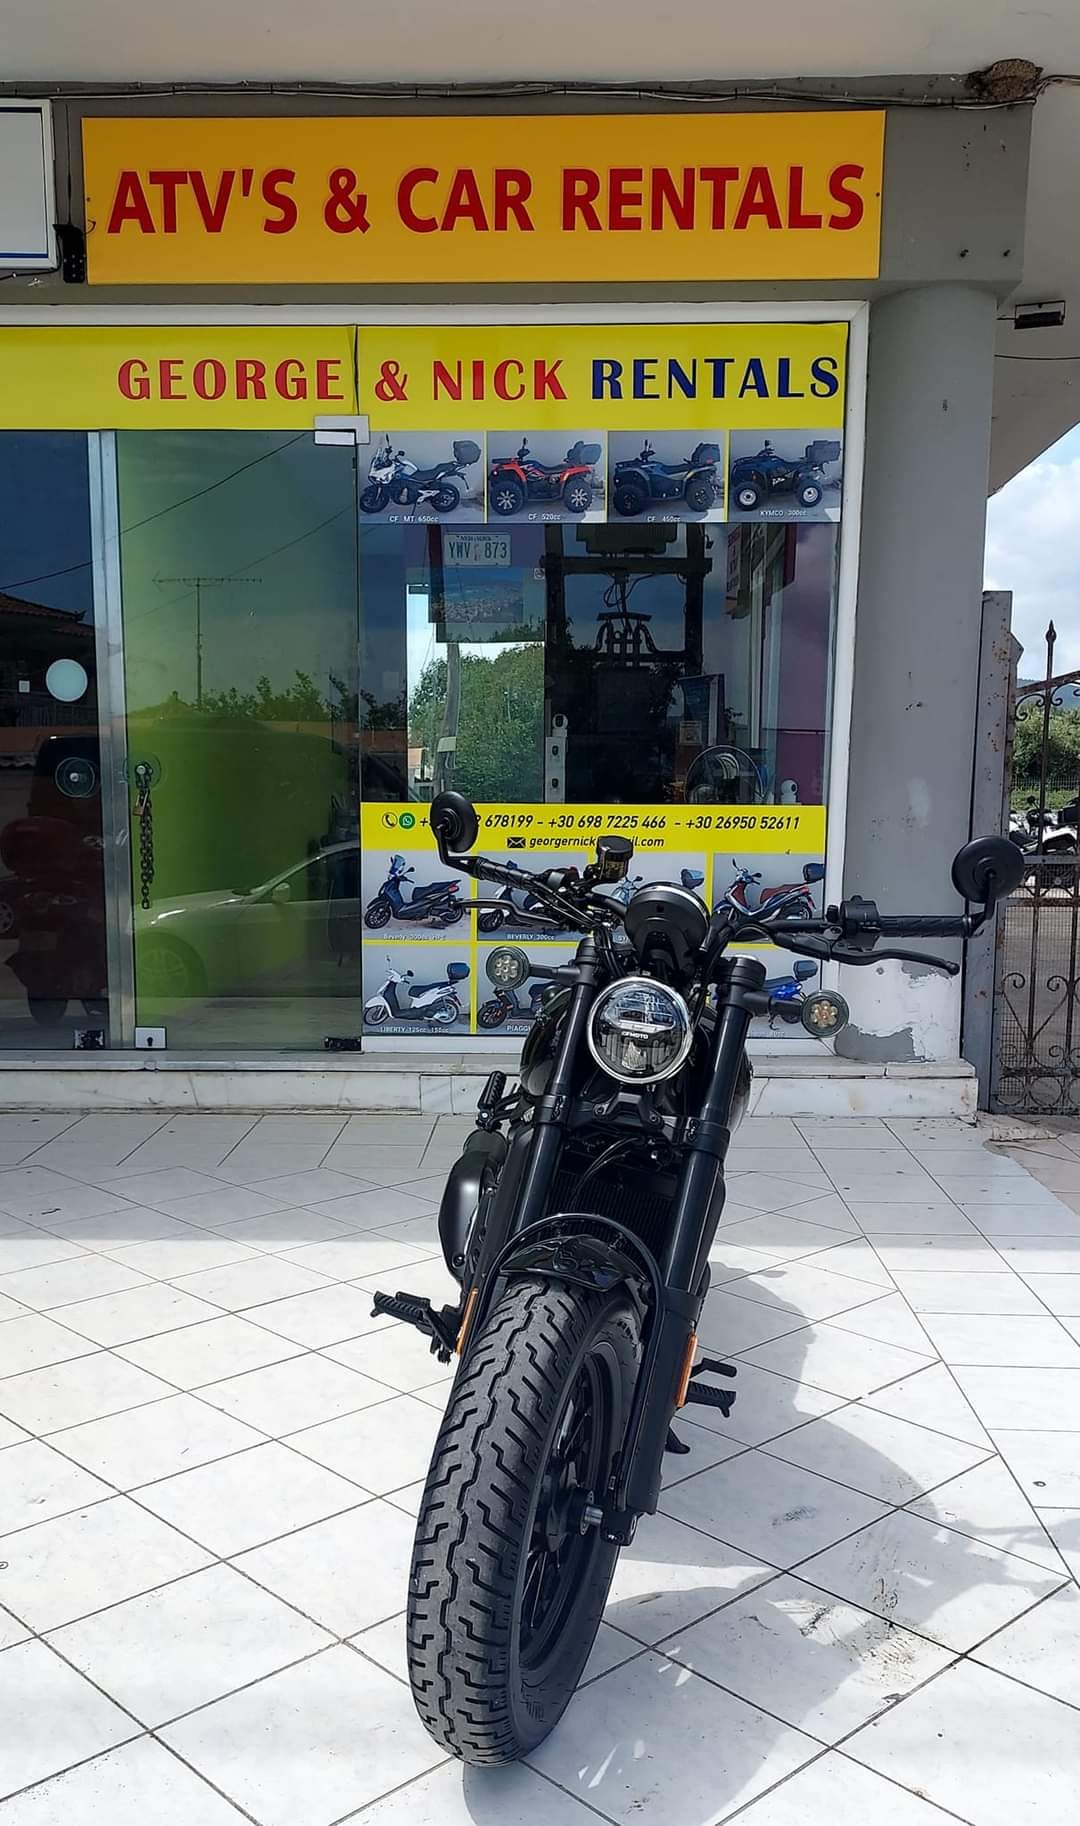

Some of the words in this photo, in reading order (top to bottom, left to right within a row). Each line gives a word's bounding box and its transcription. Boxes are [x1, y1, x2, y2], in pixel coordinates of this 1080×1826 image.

[105, 167, 299, 235] ATV'S
[322, 167, 370, 234] &
[396, 167, 534, 233] CAR
[561, 163, 865, 233] RENTALS
[117, 358, 344, 401] GEORGE
[374, 359, 409, 402] &
[433, 359, 566, 401] NICK
[592, 358, 840, 398] RENTALS
[528, 513, 538, 521] CF
[484, 541, 507, 559] 873
[485, 815, 533, 828] 678199
[548, 815, 574, 828] +30
[578, 815, 603, 828] 698
[606, 815, 638, 828] 7225
[642, 815, 666, 828] 466
[685, 816, 713, 829] +30
[715, 816, 756, 829] 26950
[760, 816, 800, 829] 52611
